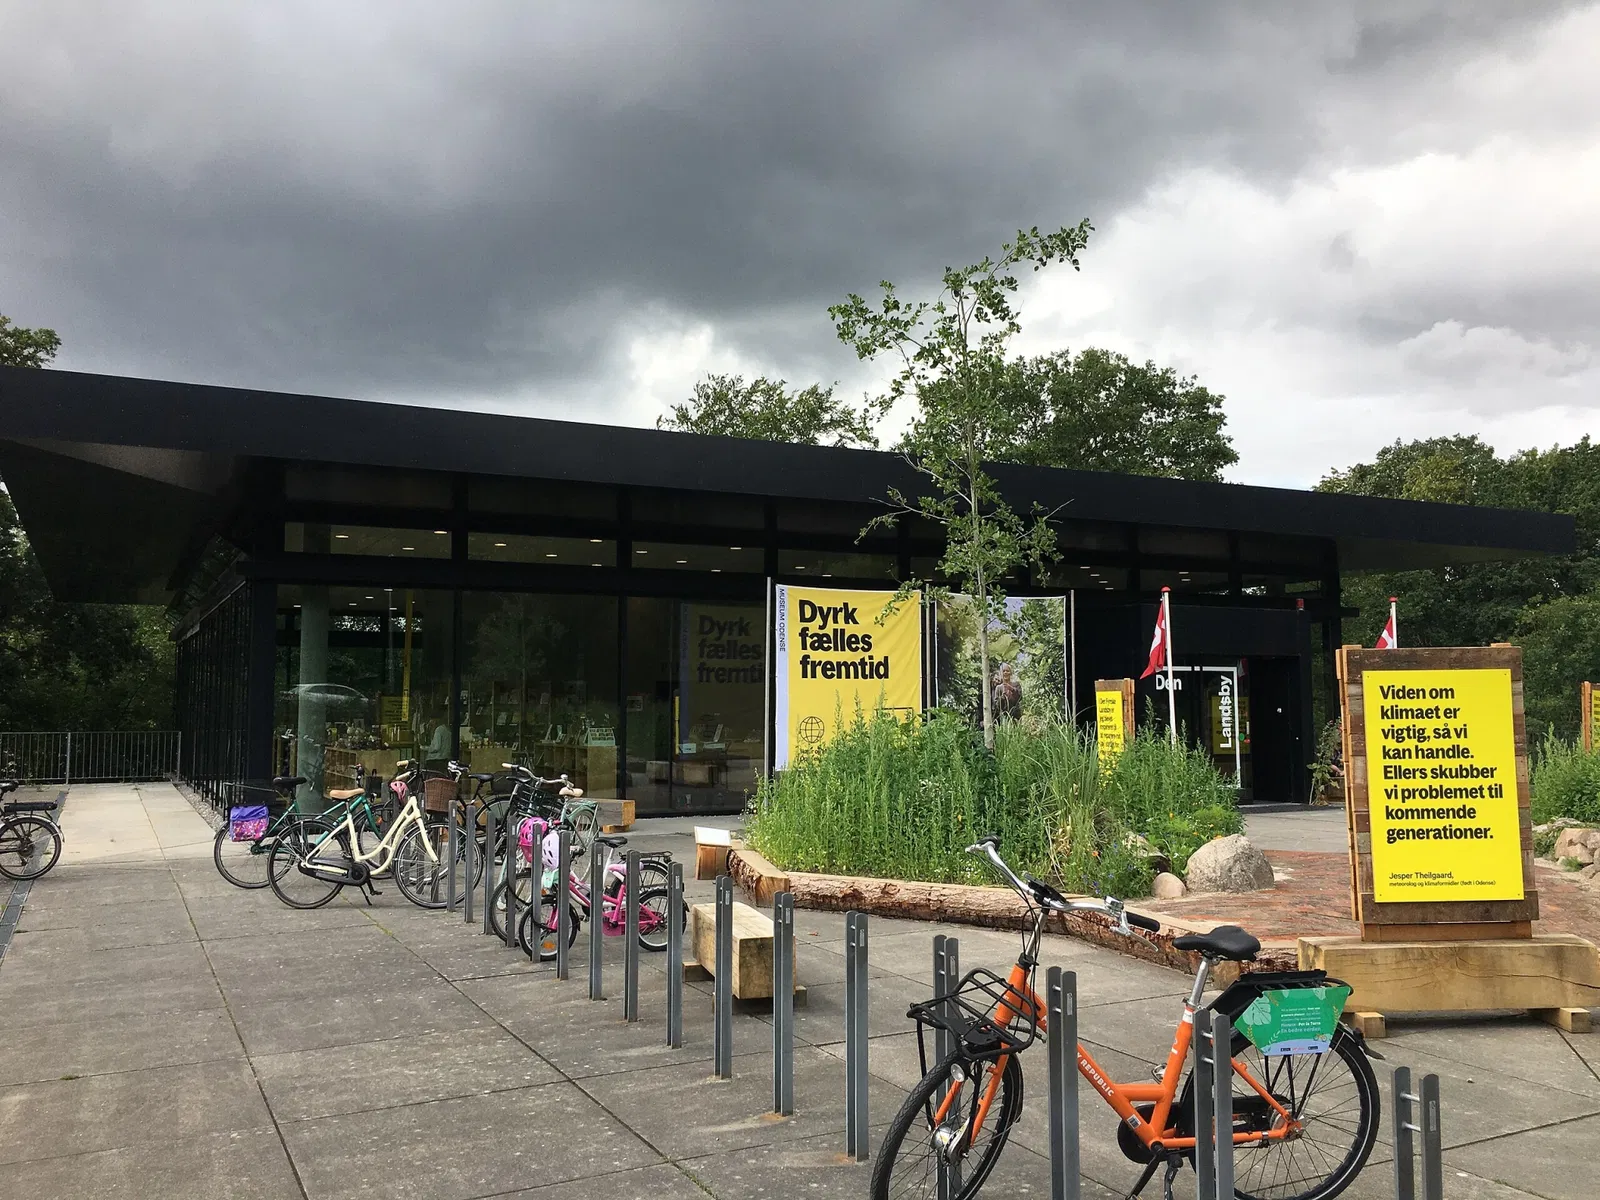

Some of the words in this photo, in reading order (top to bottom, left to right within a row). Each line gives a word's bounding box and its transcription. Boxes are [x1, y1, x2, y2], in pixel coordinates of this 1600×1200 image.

[798, 599, 860, 631] Dyrk
[698, 614, 752, 641] Dyrk
[798, 626, 873, 653] fælles
[697, 661, 764, 684] fremti
[799, 654, 889, 680] fremtid
[1155, 674, 1182, 691] Den
[1379, 685, 1427, 700] Viden
[1428, 687, 1455, 700] om
[1218, 675, 1233, 749] Landsby
[1380, 705, 1441, 720] klimaet
[1443, 707, 1461, 720] er
[1381, 724, 1431, 744] vigtig,
[1433, 723, 1451, 740] så
[1453, 724, 1468, 739] vi
[1382, 745, 1414, 760] kan
[1415, 744, 1475, 760] handle.
[1383, 765, 1428, 780] Ellers
[1430, 764, 1498, 780] skubber
[1384, 785, 1399, 800] vi
[1401, 784, 1485, 803] problemet
[1486, 783, 1504, 799] til
[1385, 805, 1476, 820] kommende
[1386, 824, 1494, 845] generationer.
[1388, 871, 1413, 880] Jesper
[1414, 870, 1454, 880] Theilgaard,
[1080, 1059, 1114, 1096] REPUBLIC
